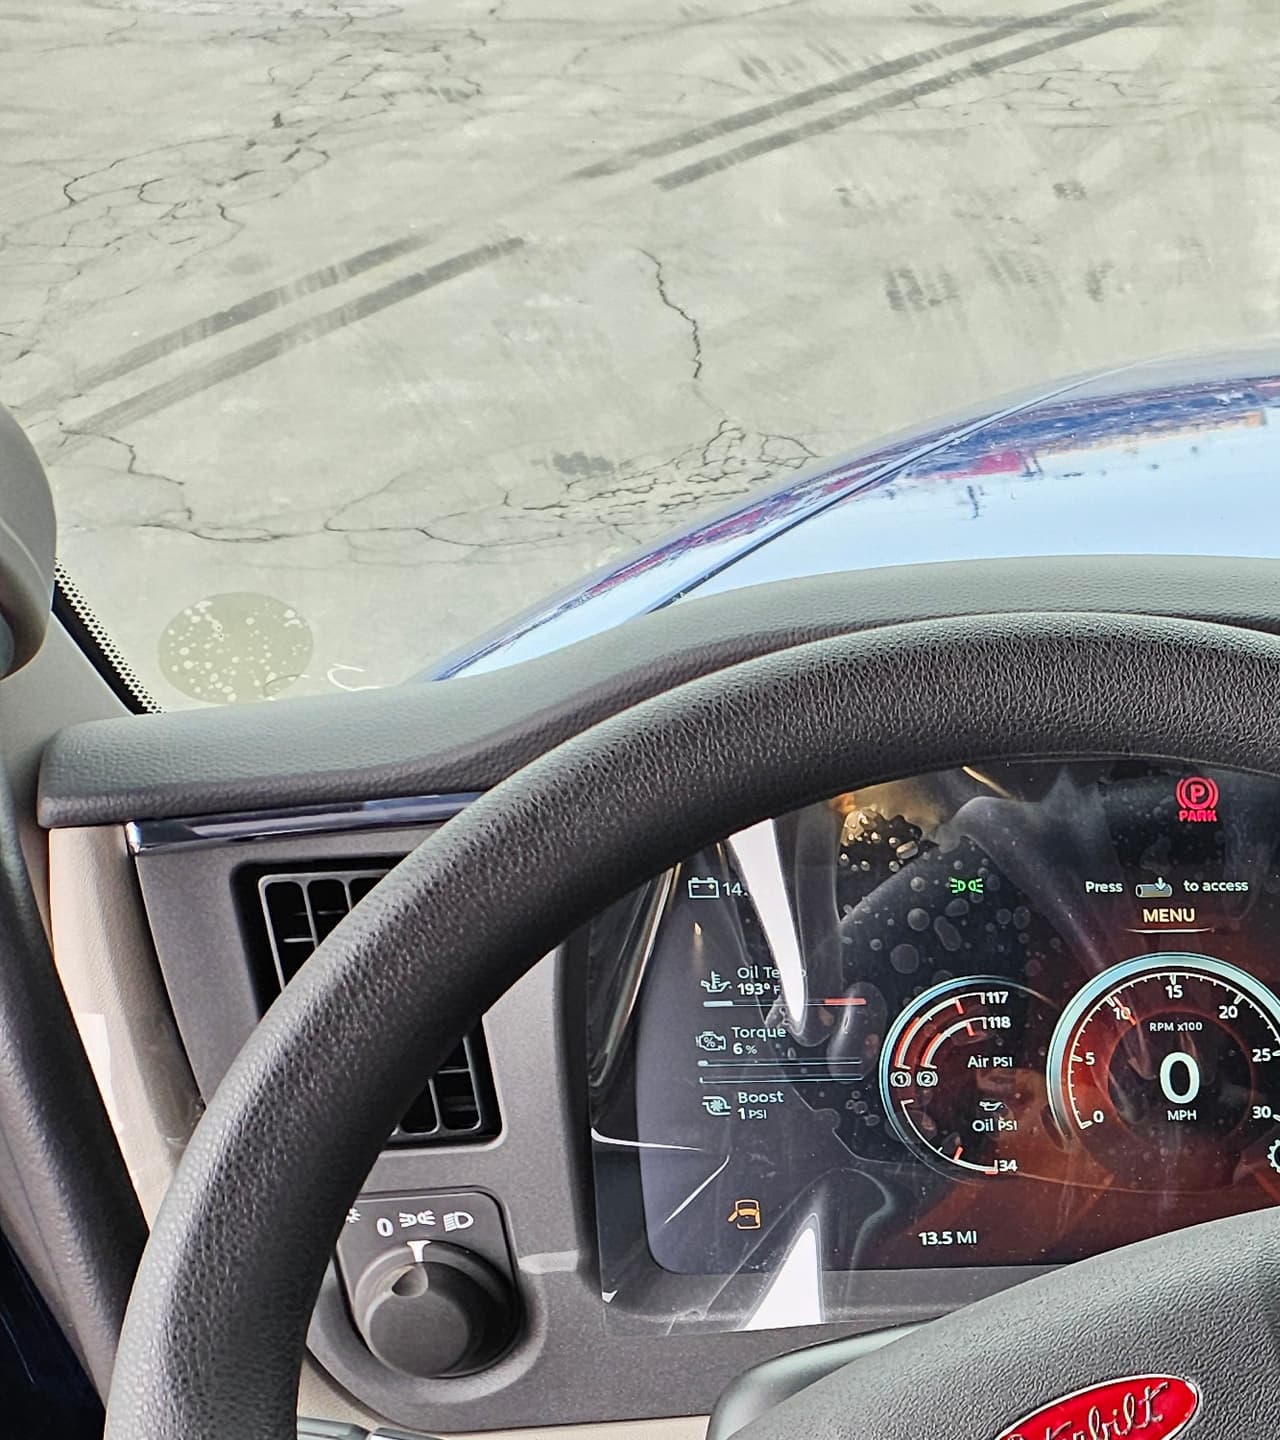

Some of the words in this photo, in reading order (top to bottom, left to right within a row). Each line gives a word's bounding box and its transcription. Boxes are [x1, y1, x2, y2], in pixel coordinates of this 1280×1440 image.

[1178, 810, 1217, 822] PARK
[1085, 880, 1123, 893] Press
[1184, 880, 1200, 892] to
[1202, 881, 1249, 893] access
[1143, 909, 1196, 922] MENU
[737, 965, 758, 979] Oil
[986, 992, 1009, 1004] 117
[1166, 986, 1183, 999] 15
[1114, 1007, 1131, 1020] 10
[1219, 1005, 1238, 1019] 20
[988, 1017, 1011, 1029] 118
[1150, 1022, 1174, 1032] RPM
[1177, 1022, 1203, 1032] x100
[731, 1026, 787, 1042] Torque
[733, 1043, 743, 1055] 6
[1252, 1049, 1271, 1062] 25
[967, 1056, 990, 1068] Air
[993, 1057, 1013, 1068] PSI
[1085, 1052, 1095, 1065] 5
[1160, 1052, 1200, 1104] 0
[738, 1091, 784, 1104] Boost
[738, 1108, 747, 1120] 1
[748, 1109, 767, 1120] PSI
[1093, 1111, 1104, 1123] 0
[1167, 1110, 1197, 1121] MPH
[1252, 1106, 1271, 1119] 30
[972, 1119, 994, 1132] Oil
[998, 1120, 1018, 1131] PSI
[999, 1160, 1018, 1172] 34
[918, 1232, 953, 1246] 13.5
[957, 1231, 978, 1244] MI
